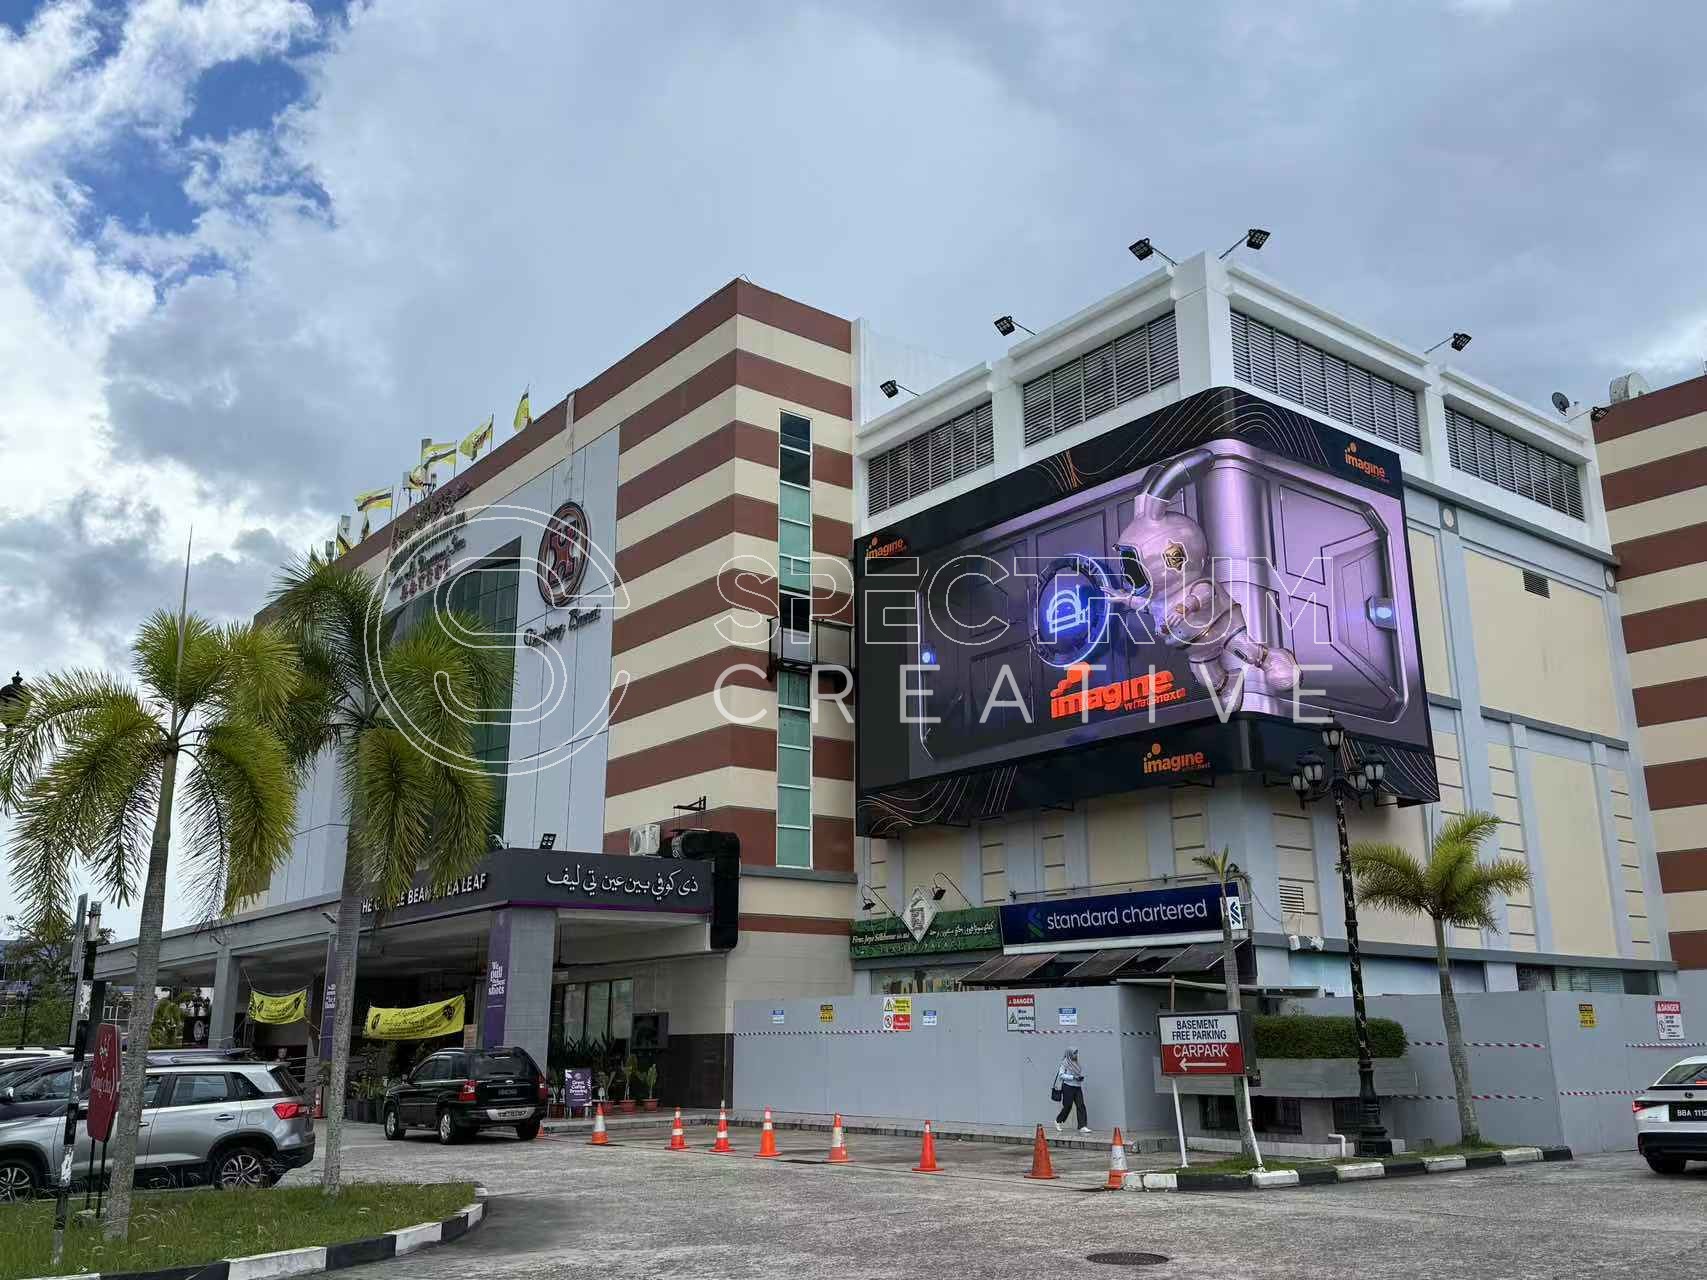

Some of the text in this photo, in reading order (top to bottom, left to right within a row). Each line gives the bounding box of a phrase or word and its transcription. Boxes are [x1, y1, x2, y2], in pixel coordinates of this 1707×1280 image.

[1344, 448, 1386, 480] imagine
[1050, 669, 1174, 719] imagine
[1143, 750, 1204, 774] imagine
[361, 897, 373, 915] HE
[461, 873, 487, 892] LEAF
[1047, 899, 1208, 931] standard chartered
[1172, 1030, 1227, 1041] FREE PARKING
[1176, 1019, 1219, 1030] BASEMENT
[1173, 1044, 1229, 1058] CARPARK
